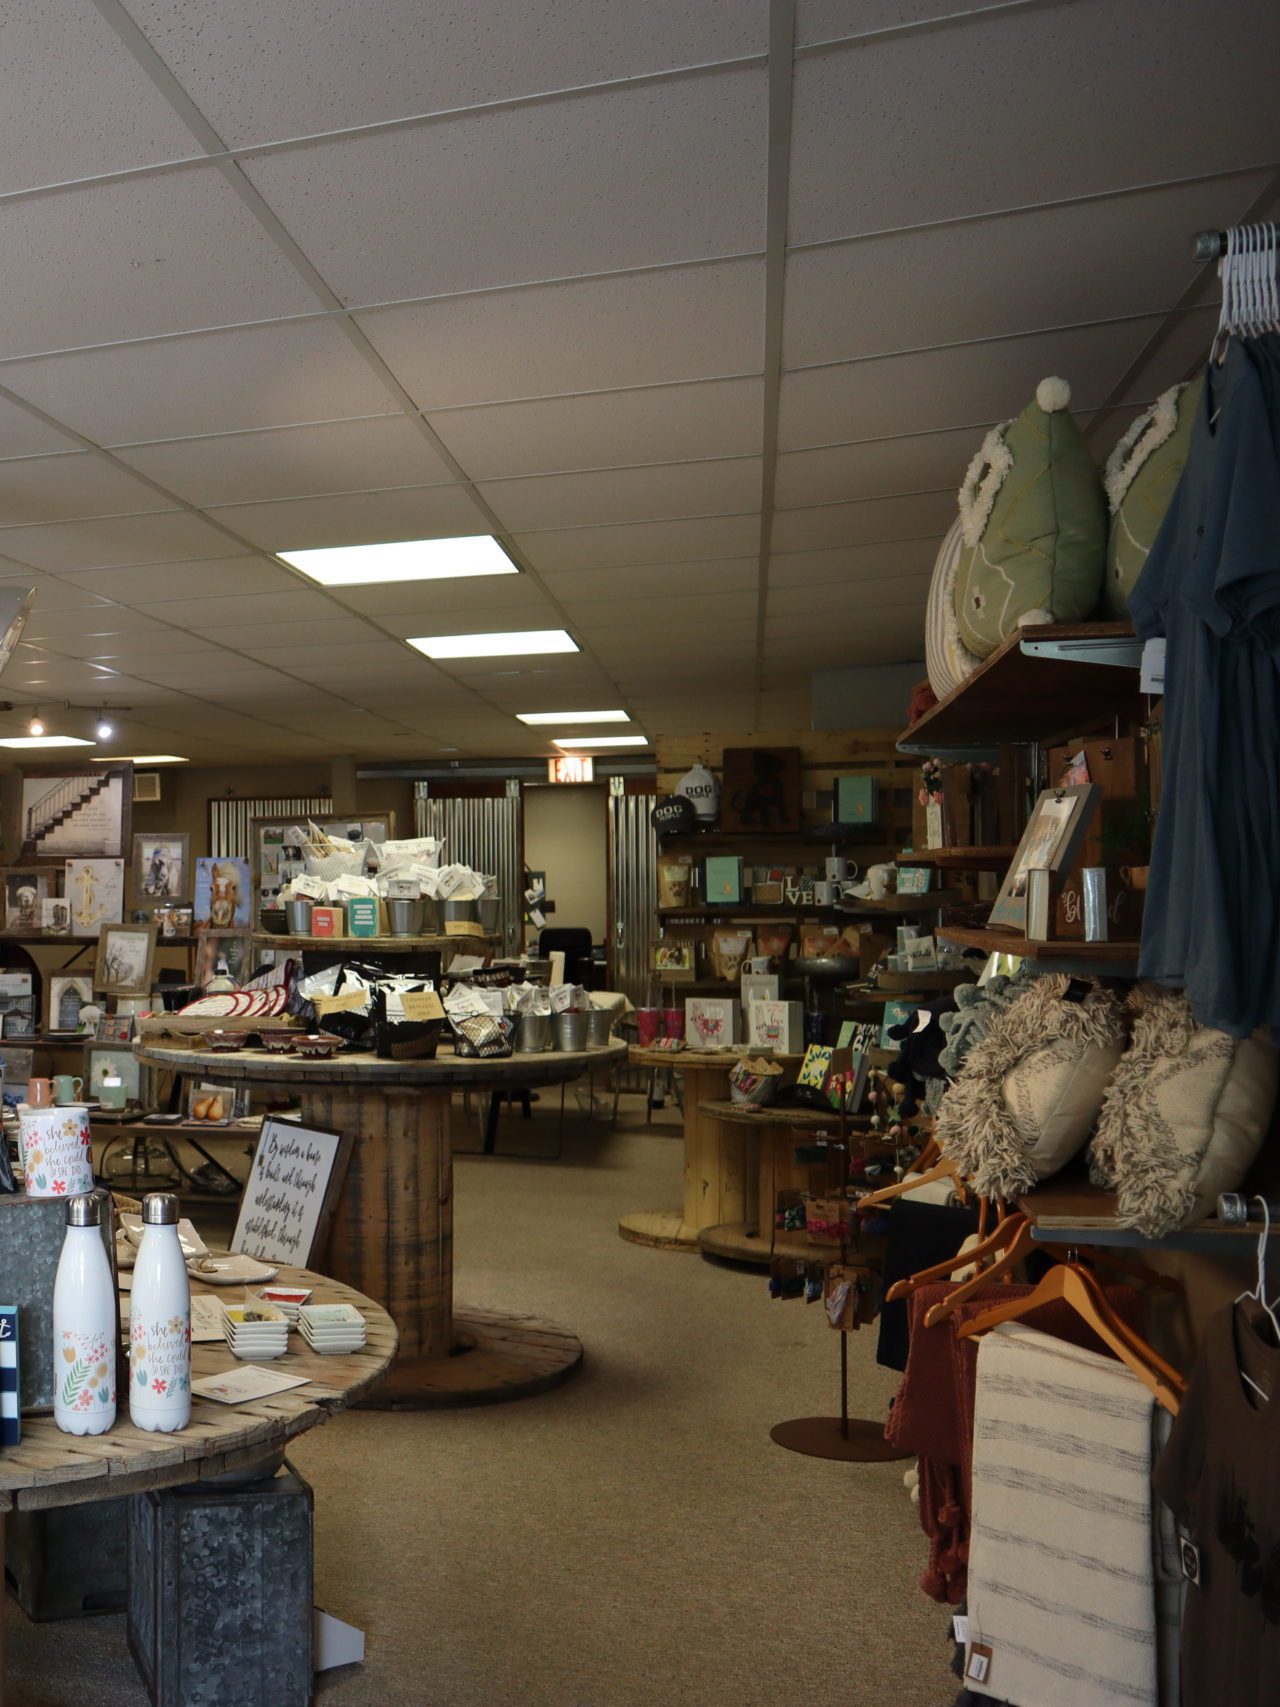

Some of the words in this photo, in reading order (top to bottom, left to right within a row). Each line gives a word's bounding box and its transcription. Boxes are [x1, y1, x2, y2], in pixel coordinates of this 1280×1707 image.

[554, 757, 587, 783] EXIT
[685, 784, 712, 796] DOG
[655, 804, 683, 818] DOG
[46, 1124, 63, 1140] she
[44, 1135, 80, 1155] believed
[45, 1151, 62, 1167] she
[64, 1149, 84, 1164] could
[49, 1166, 58, 1178] SO
[57, 1166, 69, 1178] SHE
[151, 1321, 169, 1337] she
[147, 1333, 184, 1351] believed
[147, 1352, 162, 1365] she
[166, 1350, 187, 1363] could
[152, 1364, 160, 1376] SO
[160, 1364, 170, 1376] SHE
